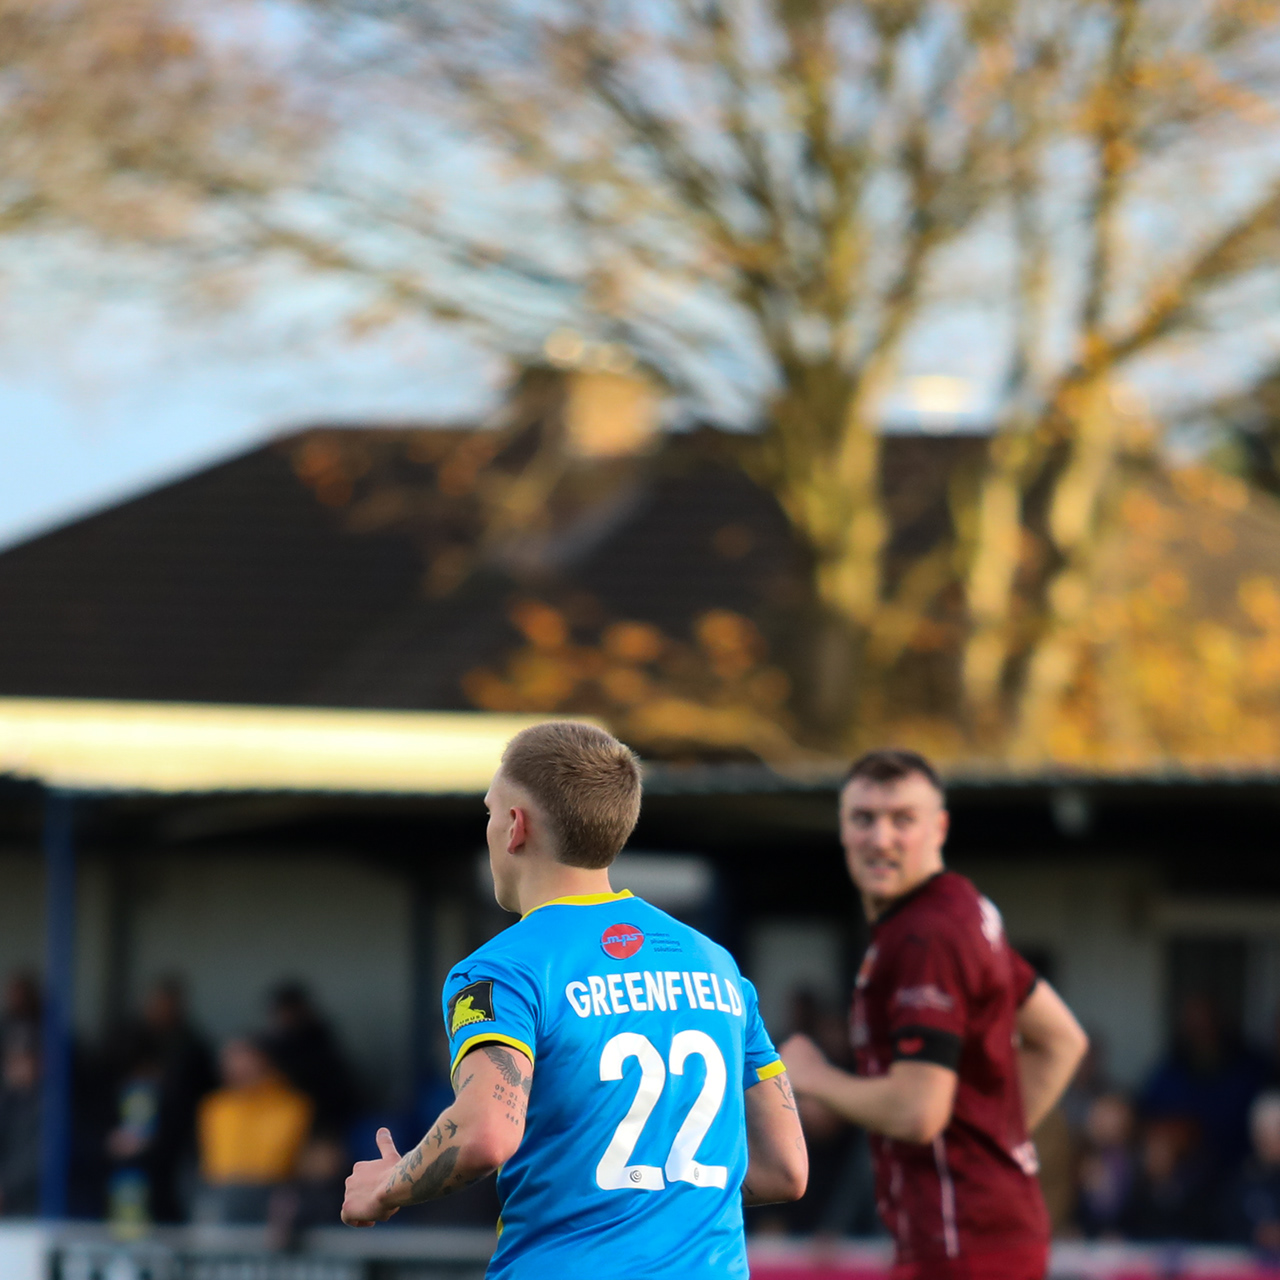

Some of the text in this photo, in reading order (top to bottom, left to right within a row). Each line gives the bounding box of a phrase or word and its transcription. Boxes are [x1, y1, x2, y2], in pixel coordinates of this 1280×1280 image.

[650, 938, 681, 947] plumbing
[566, 971, 742, 1018] GREENFIELD
[596, 1030, 728, 1190] 22
